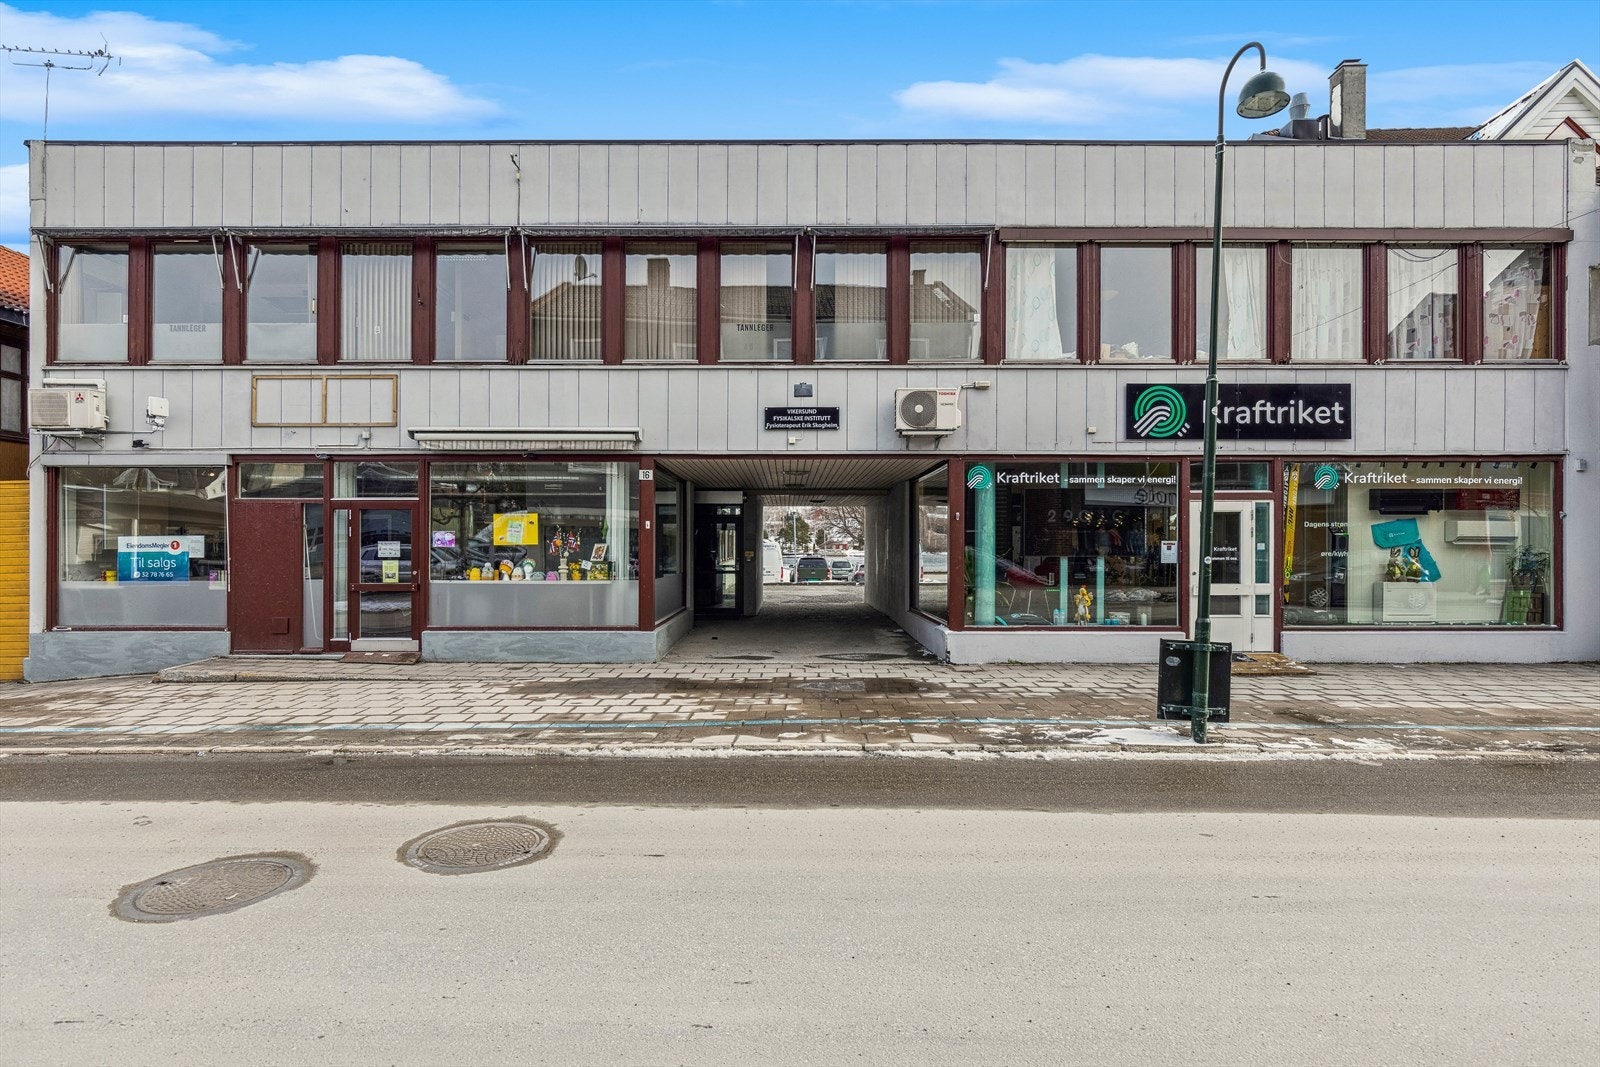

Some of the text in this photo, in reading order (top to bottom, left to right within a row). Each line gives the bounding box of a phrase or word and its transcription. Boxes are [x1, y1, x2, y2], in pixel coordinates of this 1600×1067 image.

[169, 324, 206, 332] TANNLEGER
[737, 323, 774, 331] TANNLEGER
[642, 471, 650, 479] 16
[996, 471, 1060, 484] Kraftriket
[1069, 475, 1105, 484] sammen
[1107, 475, 1136, 485] skaper
[1137, 475, 1145, 484] vi
[1147, 475, 1177, 485] energi!
[1344, 472, 1407, 484] Kraftriket
[1416, 476, 1452, 484] sammen
[1454, 476, 1482, 485] skaper
[1484, 476, 1491, 484] vi
[1493, 476, 1523, 486] energi!
[130, 557, 177, 570] Til salgs
